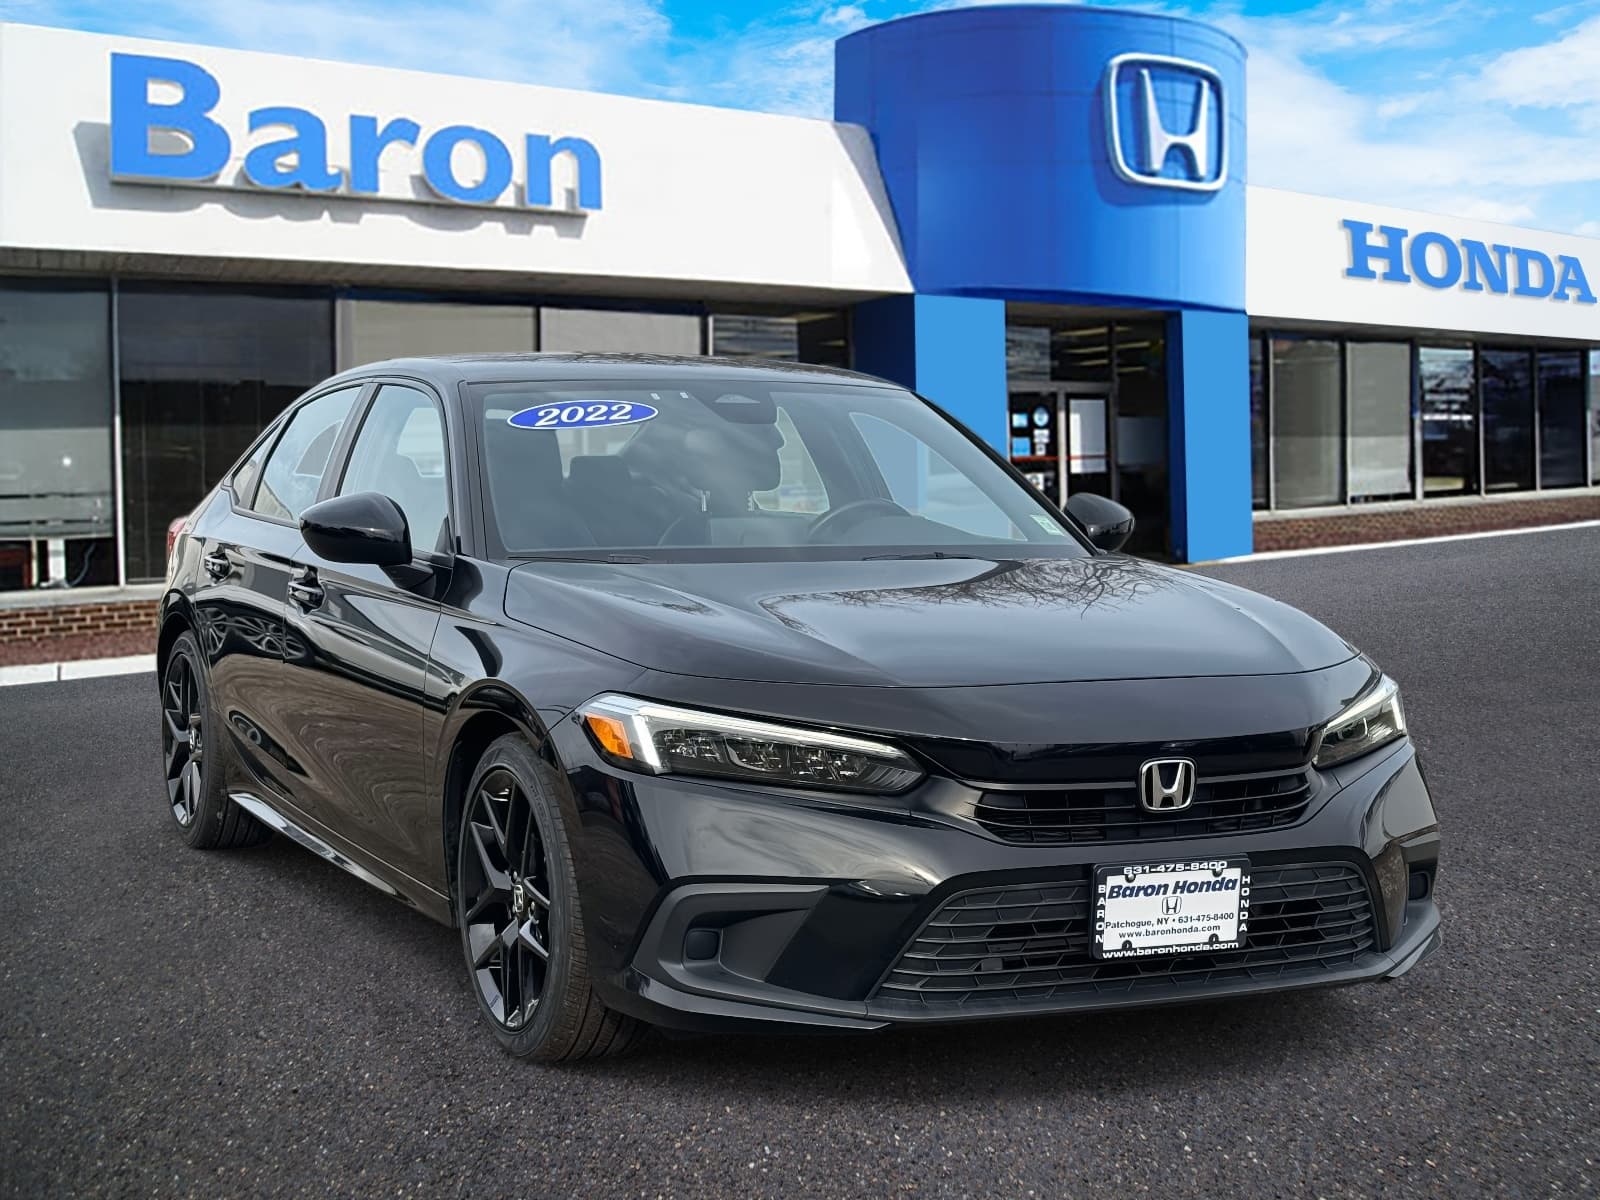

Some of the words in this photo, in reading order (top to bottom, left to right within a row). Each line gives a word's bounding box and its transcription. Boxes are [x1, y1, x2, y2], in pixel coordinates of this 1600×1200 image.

[110, 52, 603, 210] Baron
[1342, 219, 1598, 304] HONDA
[534, 404, 633, 427] 2022
[1123, 861, 1227, 874] 631-475-8400
[1107, 883, 1169, 900] Baron
[1173, 876, 1238, 895] Honda
[1095, 884, 1106, 943] BARON
[1239, 875, 1250, 932] HONDA
[1105, 919, 1154, 930] Patchogue,
[1156, 917, 1170, 926] NY
[1178, 912, 1234, 924] 631-475-8400
[1118, 924, 1221, 939] www.baronhonda.com
[1102, 941, 1239, 959] www.baronhonda.com
